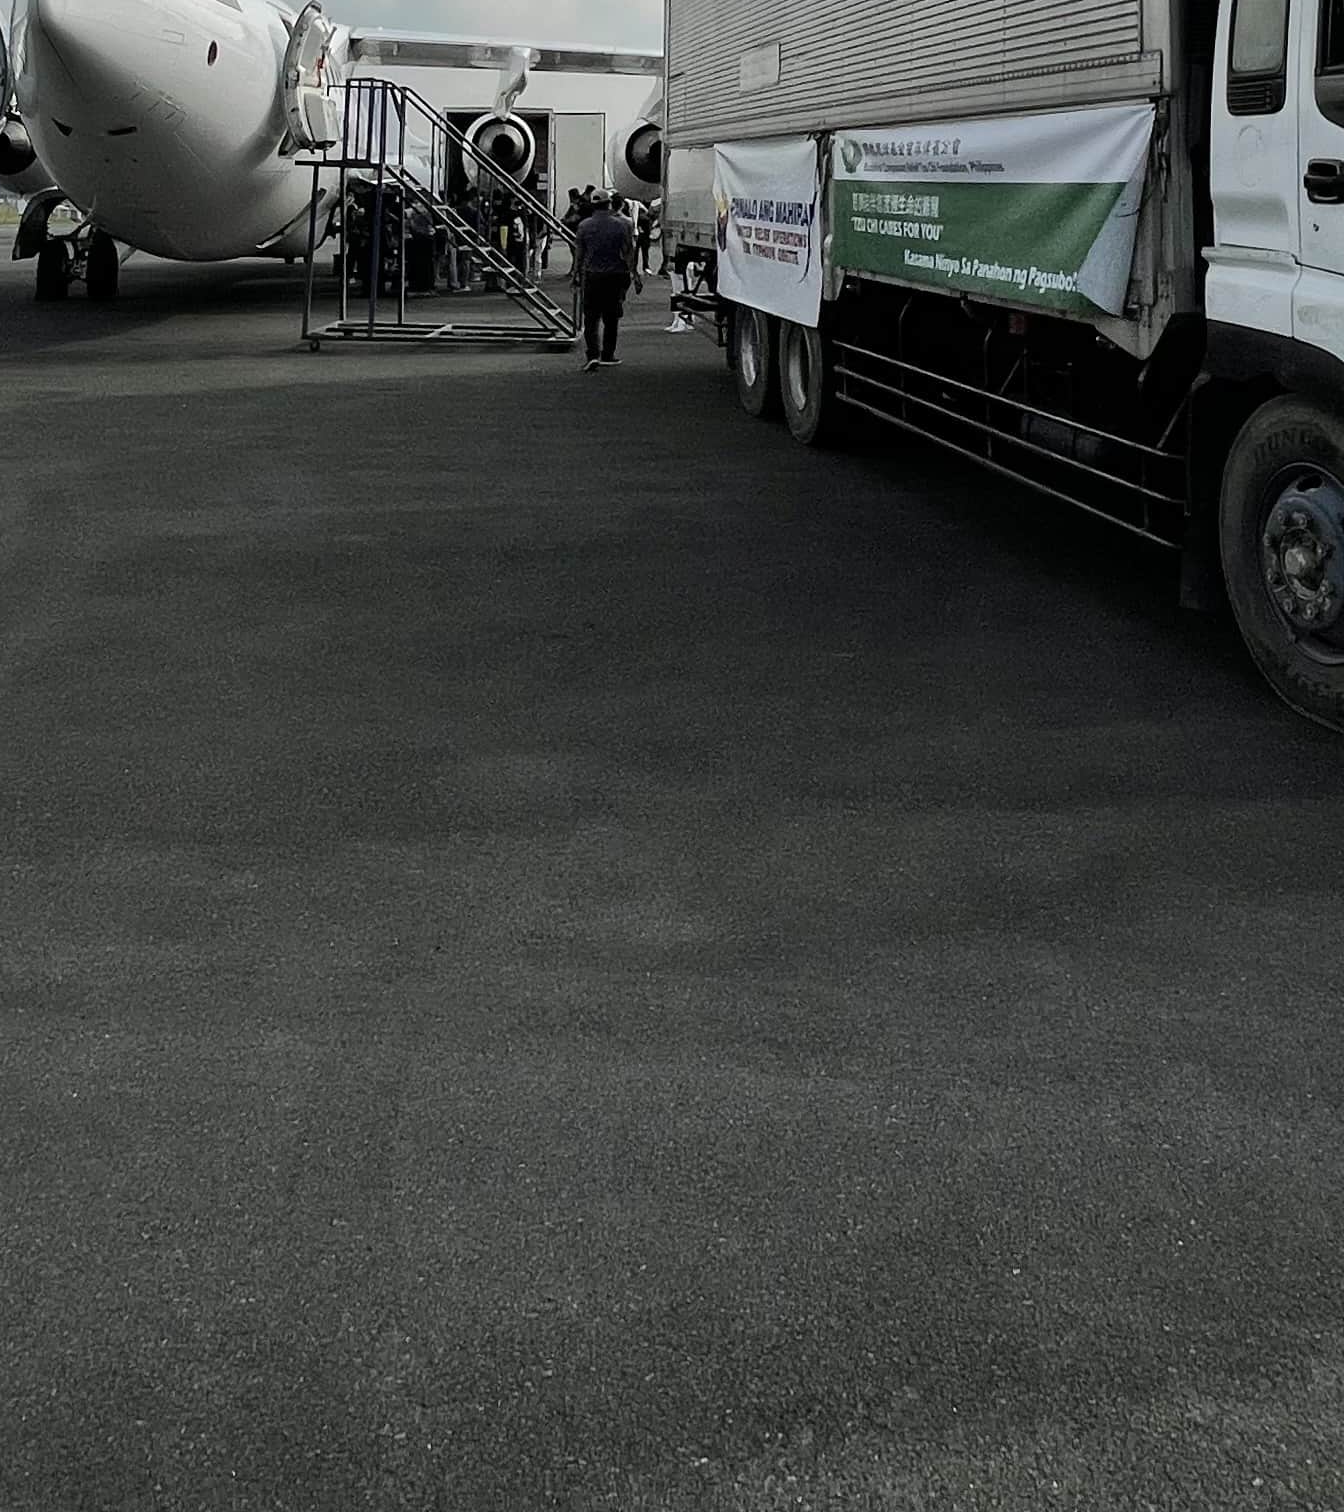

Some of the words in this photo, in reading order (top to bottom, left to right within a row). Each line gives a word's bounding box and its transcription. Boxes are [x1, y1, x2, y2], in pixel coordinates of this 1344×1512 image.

[903, 221, 920, 238] FOR
[961, 257, 972, 276] Sa
[972, 259, 1012, 282] Panahon
[1012, 268, 1028, 291] ng
